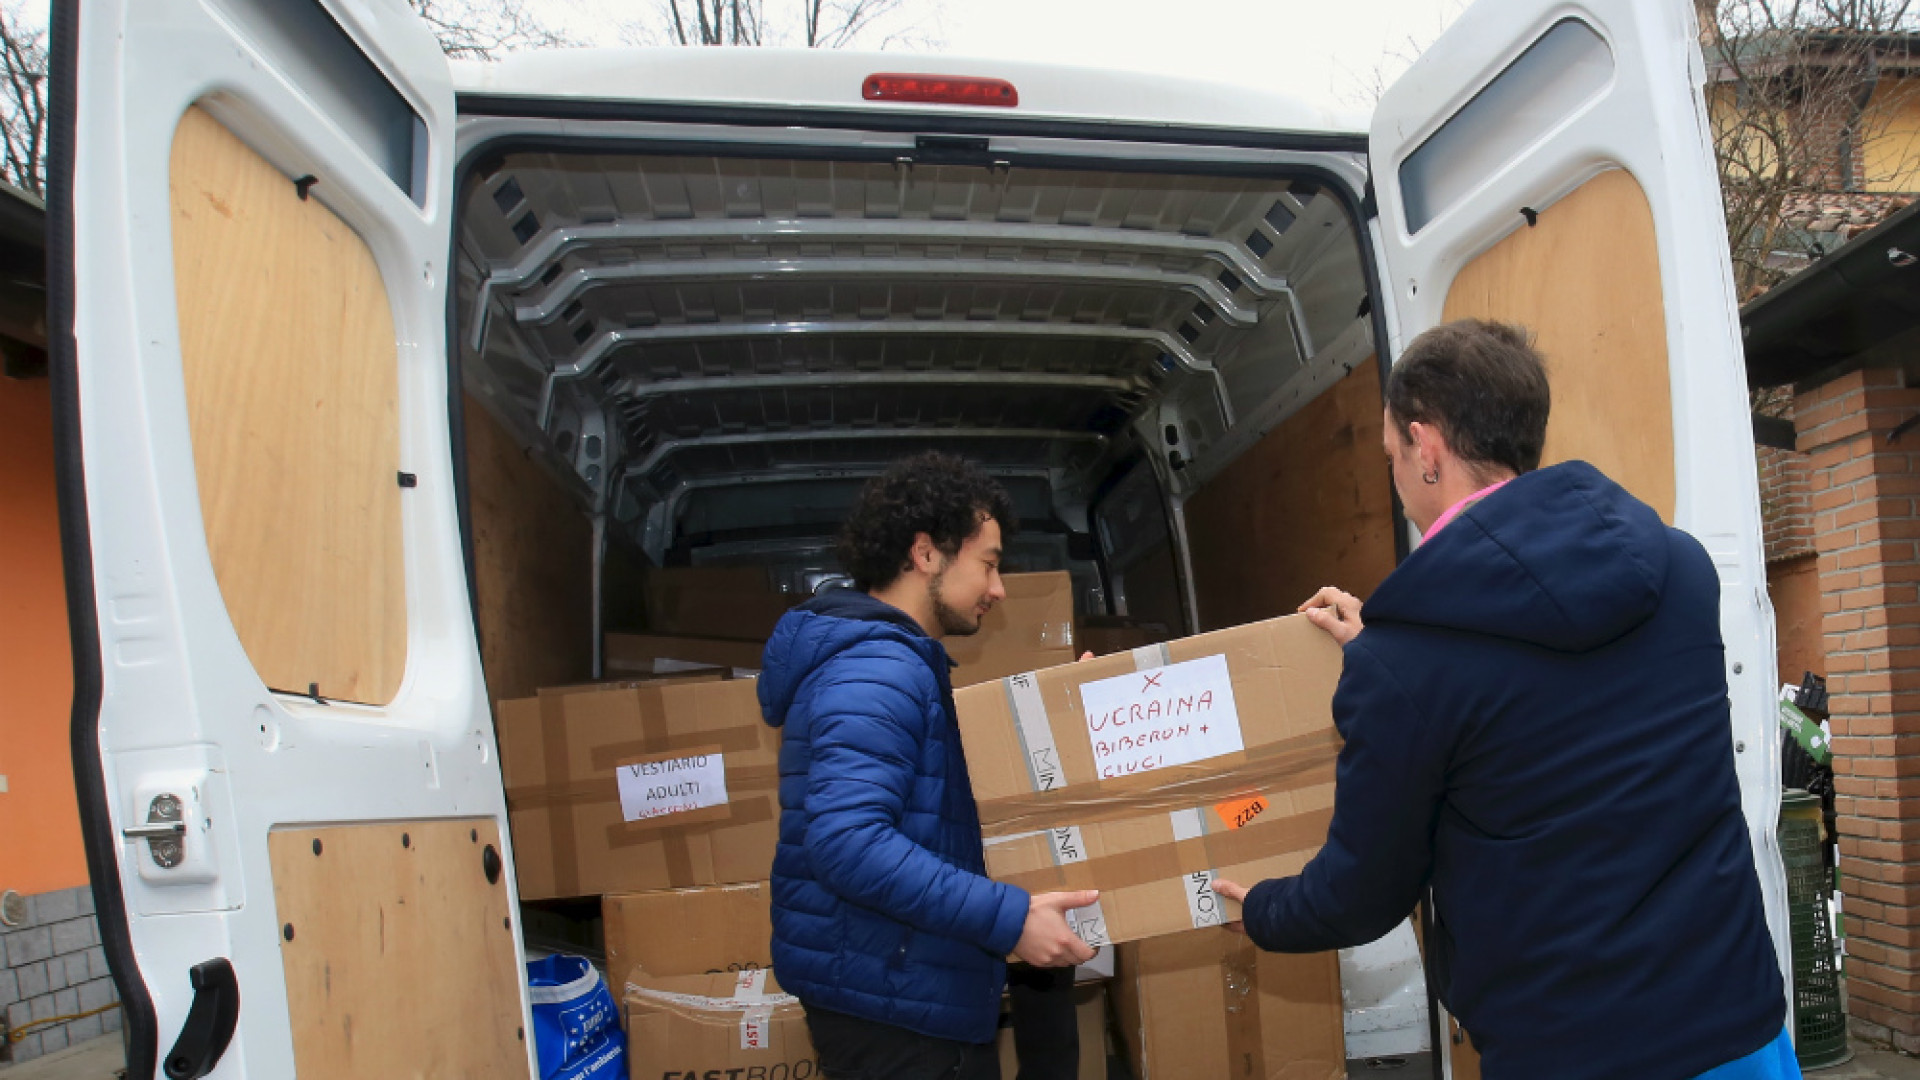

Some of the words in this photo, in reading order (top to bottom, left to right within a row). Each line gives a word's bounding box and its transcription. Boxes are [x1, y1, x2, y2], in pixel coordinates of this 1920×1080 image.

[1090, 690, 1213, 731] UCRAINA
[1096, 724, 1190, 758] BIBERON
[630, 754, 708, 778] VESTIARIO
[1103, 755, 1163, 777] CIUCI
[646, 782, 700, 801] ADULTI
